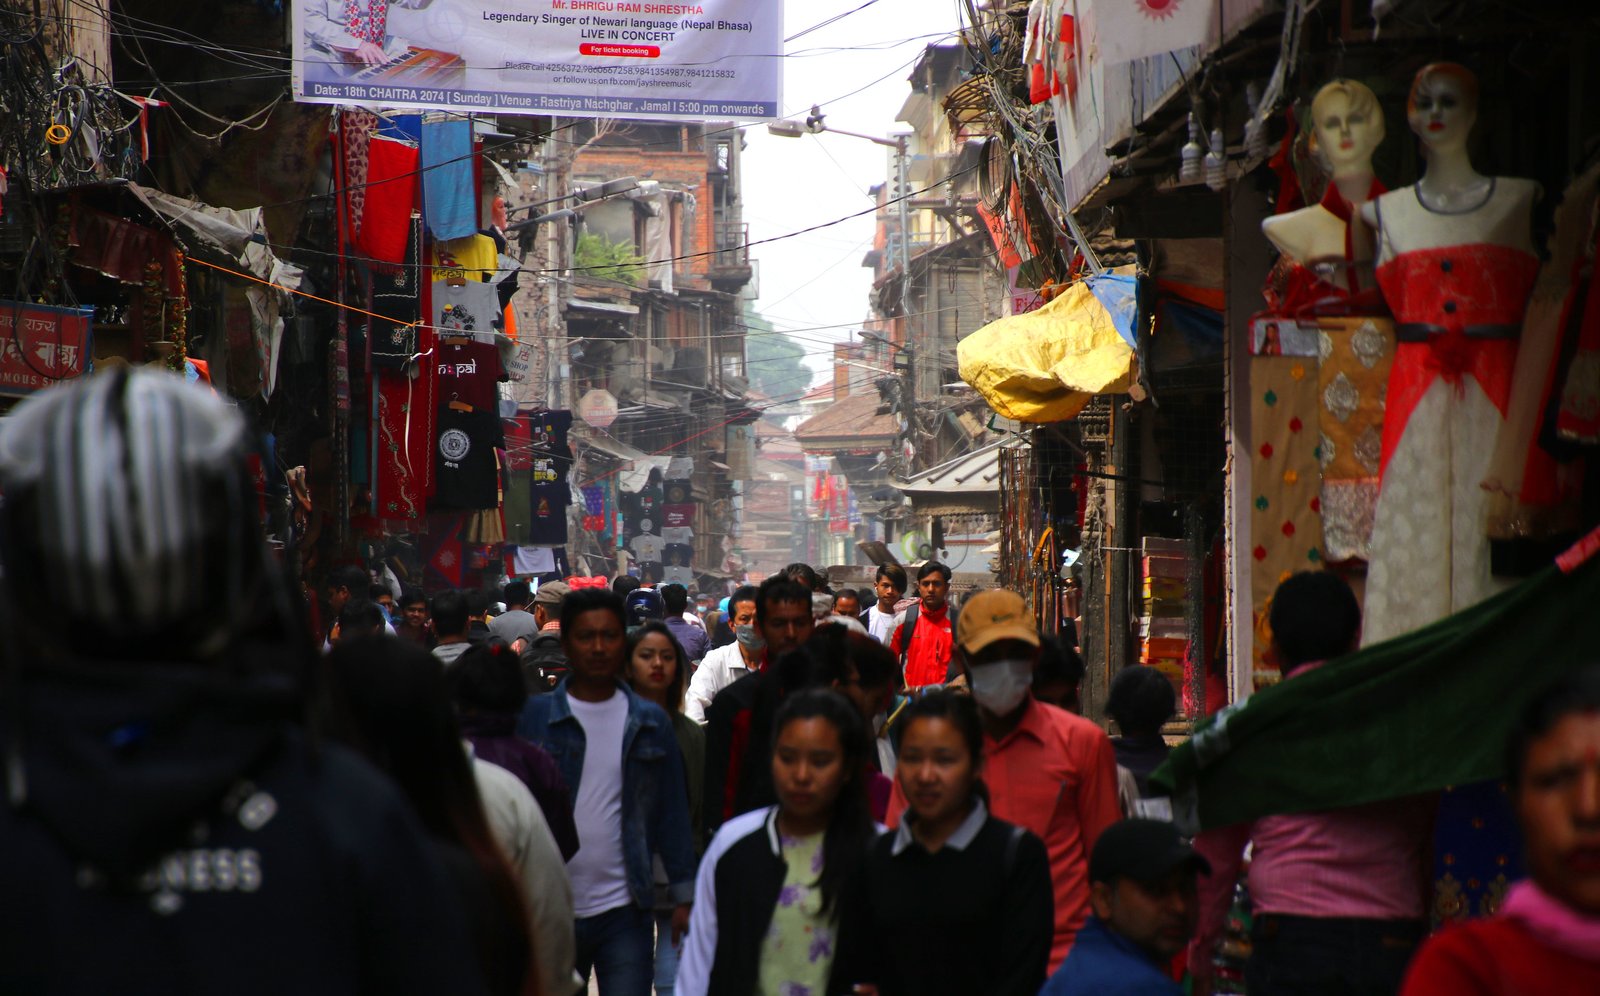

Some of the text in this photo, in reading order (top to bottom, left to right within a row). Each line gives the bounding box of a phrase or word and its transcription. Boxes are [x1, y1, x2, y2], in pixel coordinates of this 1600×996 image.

[552, 0, 704, 14] Mr. BHRIGU RAM SHRESTHA
[483, 11, 753, 32] Legendary Singer of Newari language (Nepal Bhasa)
[581, 29, 676, 41] LIVE IN CONCERT
[505, 62, 530, 70] Please
[532, 63, 545, 71] call
[563, 75, 587, 83] follow
[610, 78, 692, 88] fb.com/jayshreemusic
[314, 84, 342, 96] Date:
[344, 86, 366, 97] 18th
[369, 88, 418, 100] CHAITRA
[420, 91, 444, 102] 2074
[453, 92, 492, 107] Sunday
[500, 94, 532, 106] Venue
[541, 97, 582, 110] Rastriya
[584, 98, 633, 112] Nachghar
[640, 100, 670, 112] Jamal
[679, 102, 700, 113] 5:00
[703, 104, 718, 115] pm
[721, 104, 764, 114] onwards
[24, 318, 56, 333] राज्य
[438, 358, 476, 378] npal
